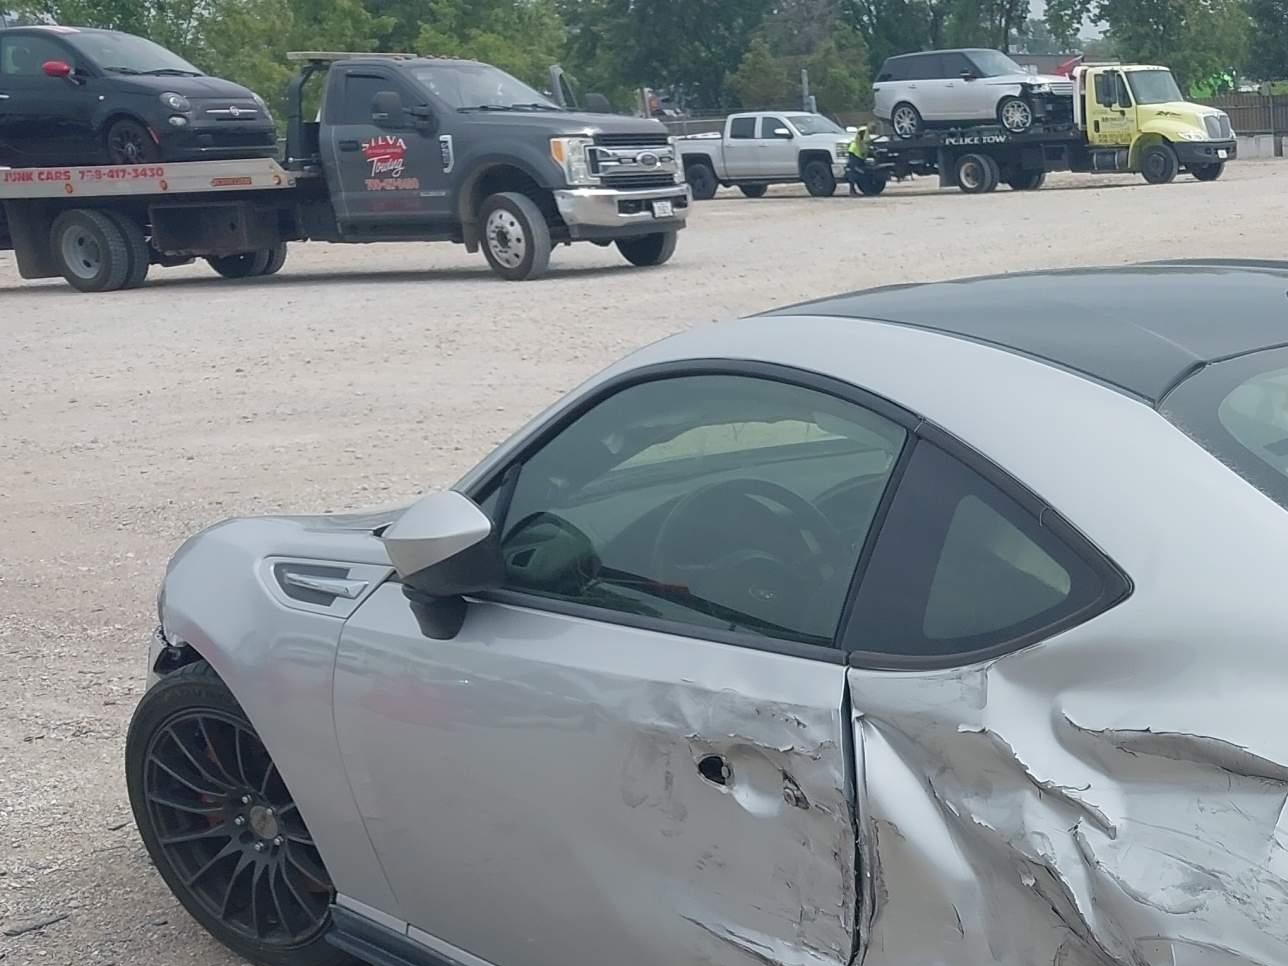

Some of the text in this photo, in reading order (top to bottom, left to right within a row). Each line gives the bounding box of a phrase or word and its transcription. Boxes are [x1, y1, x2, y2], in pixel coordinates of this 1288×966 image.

[945, 135, 1007, 146] POLICE TOW
[4, 171, 33, 183] JUNK
[37, 170, 71, 182] CARS
